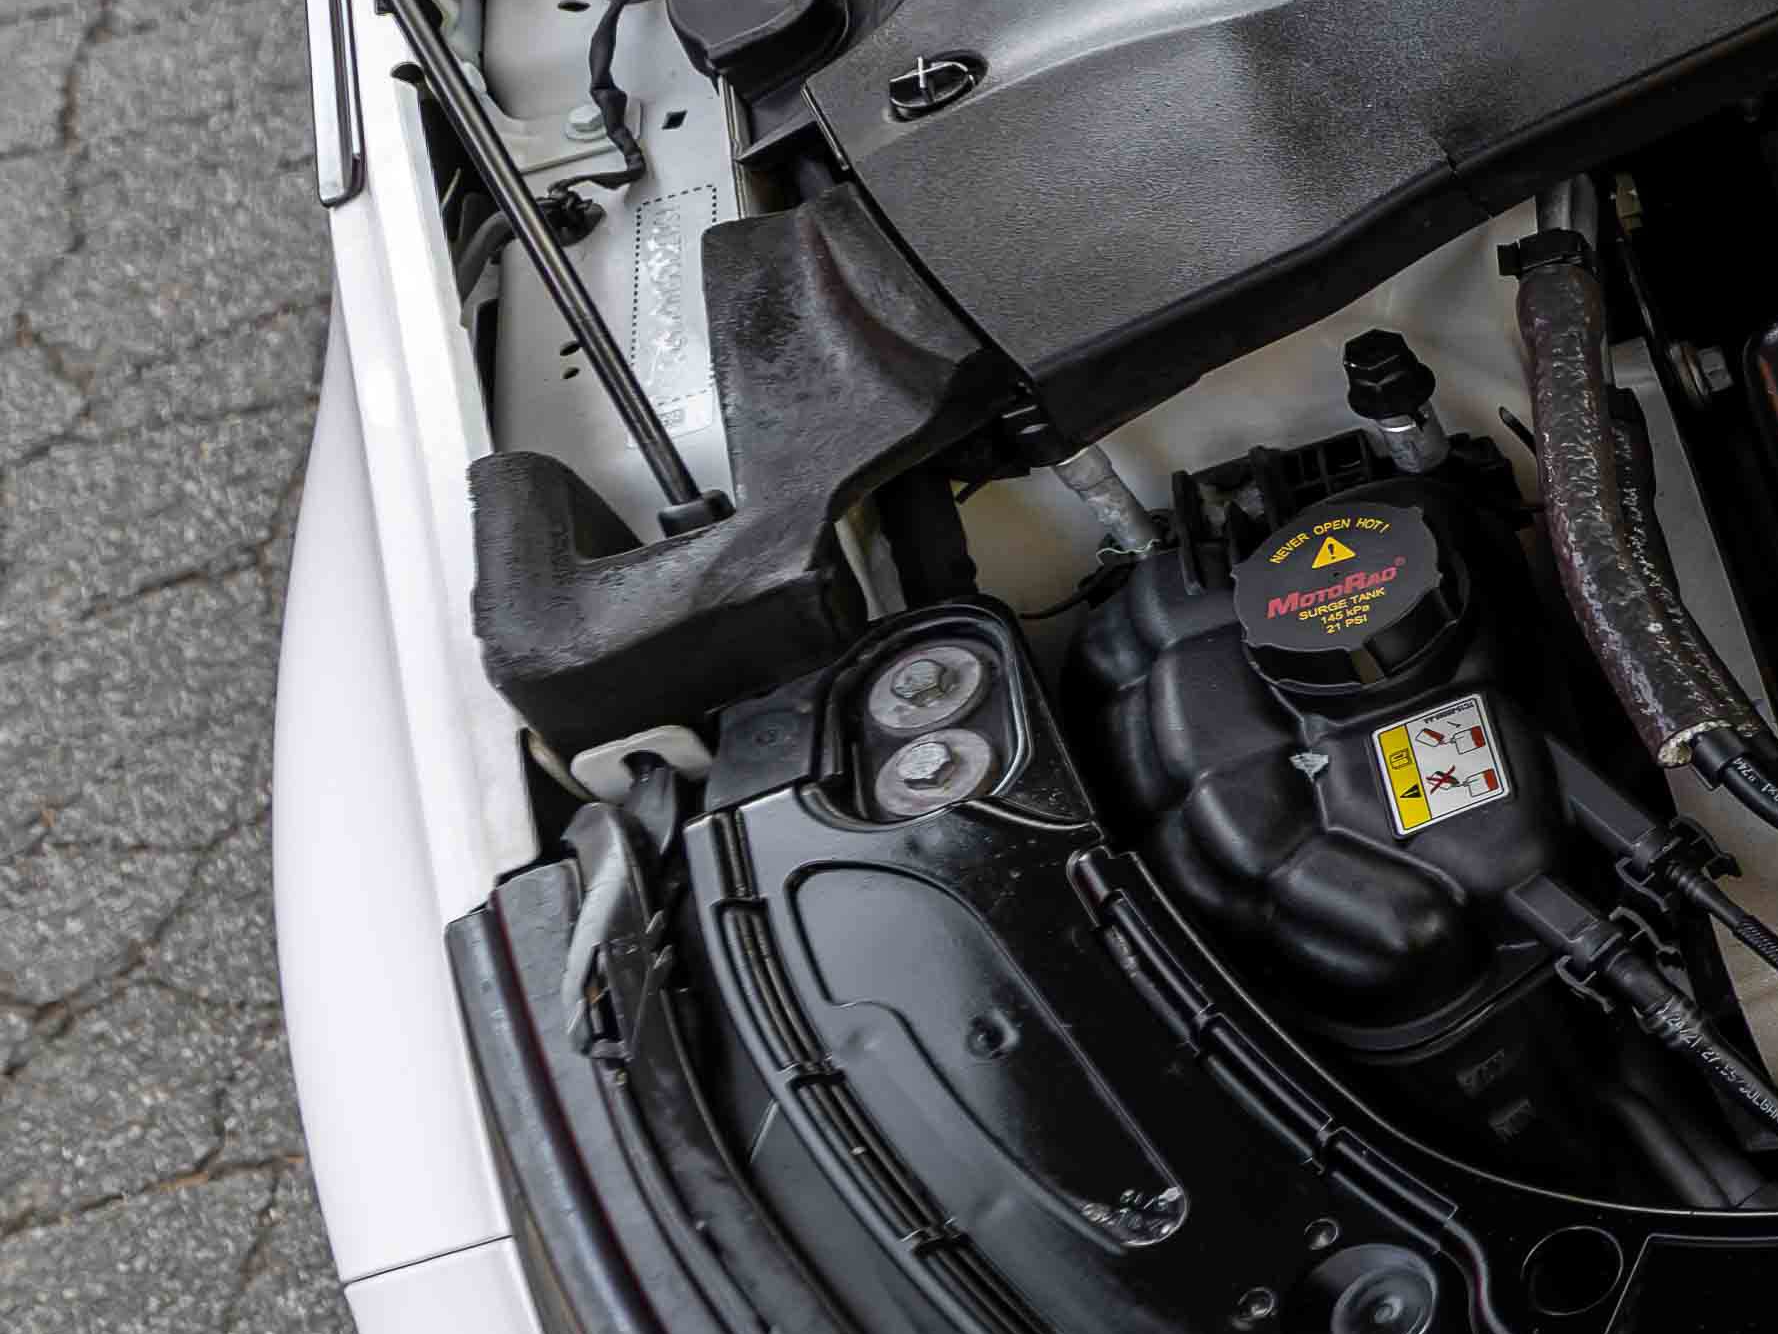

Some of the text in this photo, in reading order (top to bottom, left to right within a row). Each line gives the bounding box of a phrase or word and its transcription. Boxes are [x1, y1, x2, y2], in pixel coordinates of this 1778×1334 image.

[1269, 517, 1391, 564] NEVER OPEN HOT!
[1298, 587, 1386, 620] SURGE TANK
[1321, 610, 1344, 625] 145
[1327, 614, 1368, 634] 21 PSI
